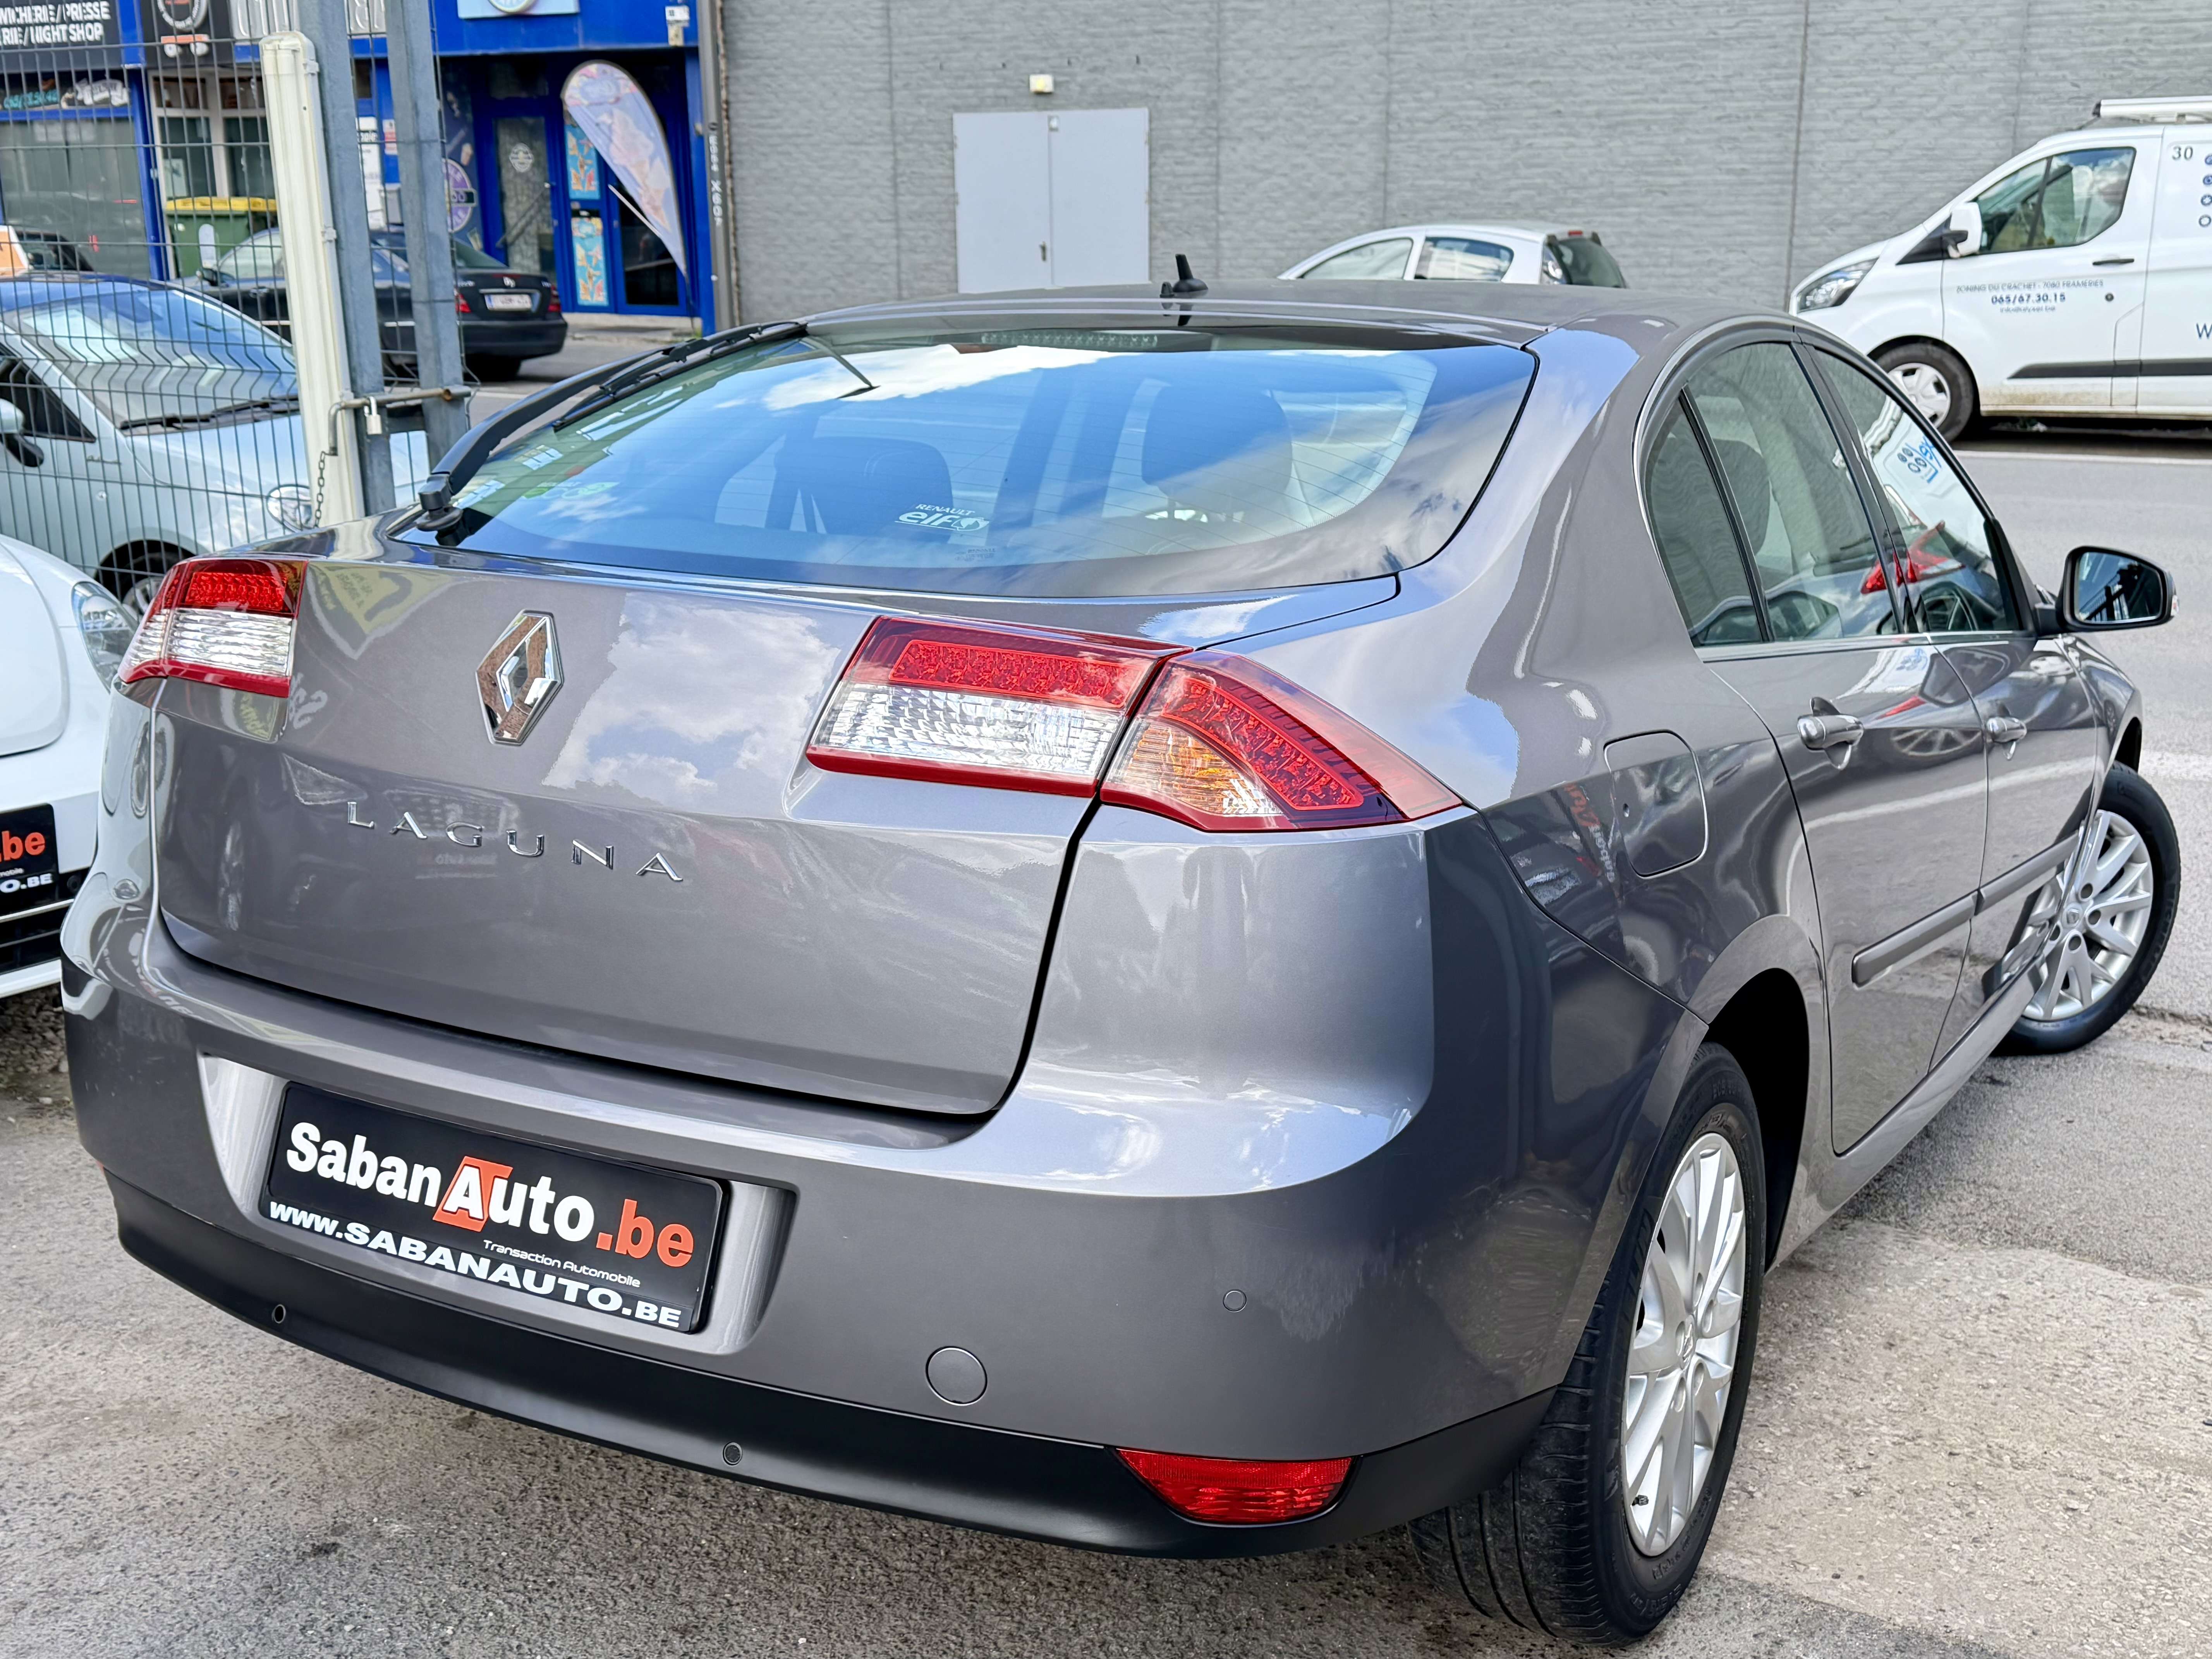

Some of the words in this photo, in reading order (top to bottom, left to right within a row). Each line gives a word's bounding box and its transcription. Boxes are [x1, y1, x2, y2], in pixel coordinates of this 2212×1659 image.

[69, 22, 104, 42] SHOP
[2172, 146, 2193, 161] 30
[915, 504, 975, 515] RENAULT
[899, 511, 961, 526] elf
[347, 801, 684, 883] LAGUNA
[483, 1239, 562, 1268] Transaction
[563, 1261, 641, 1288] Automobile
